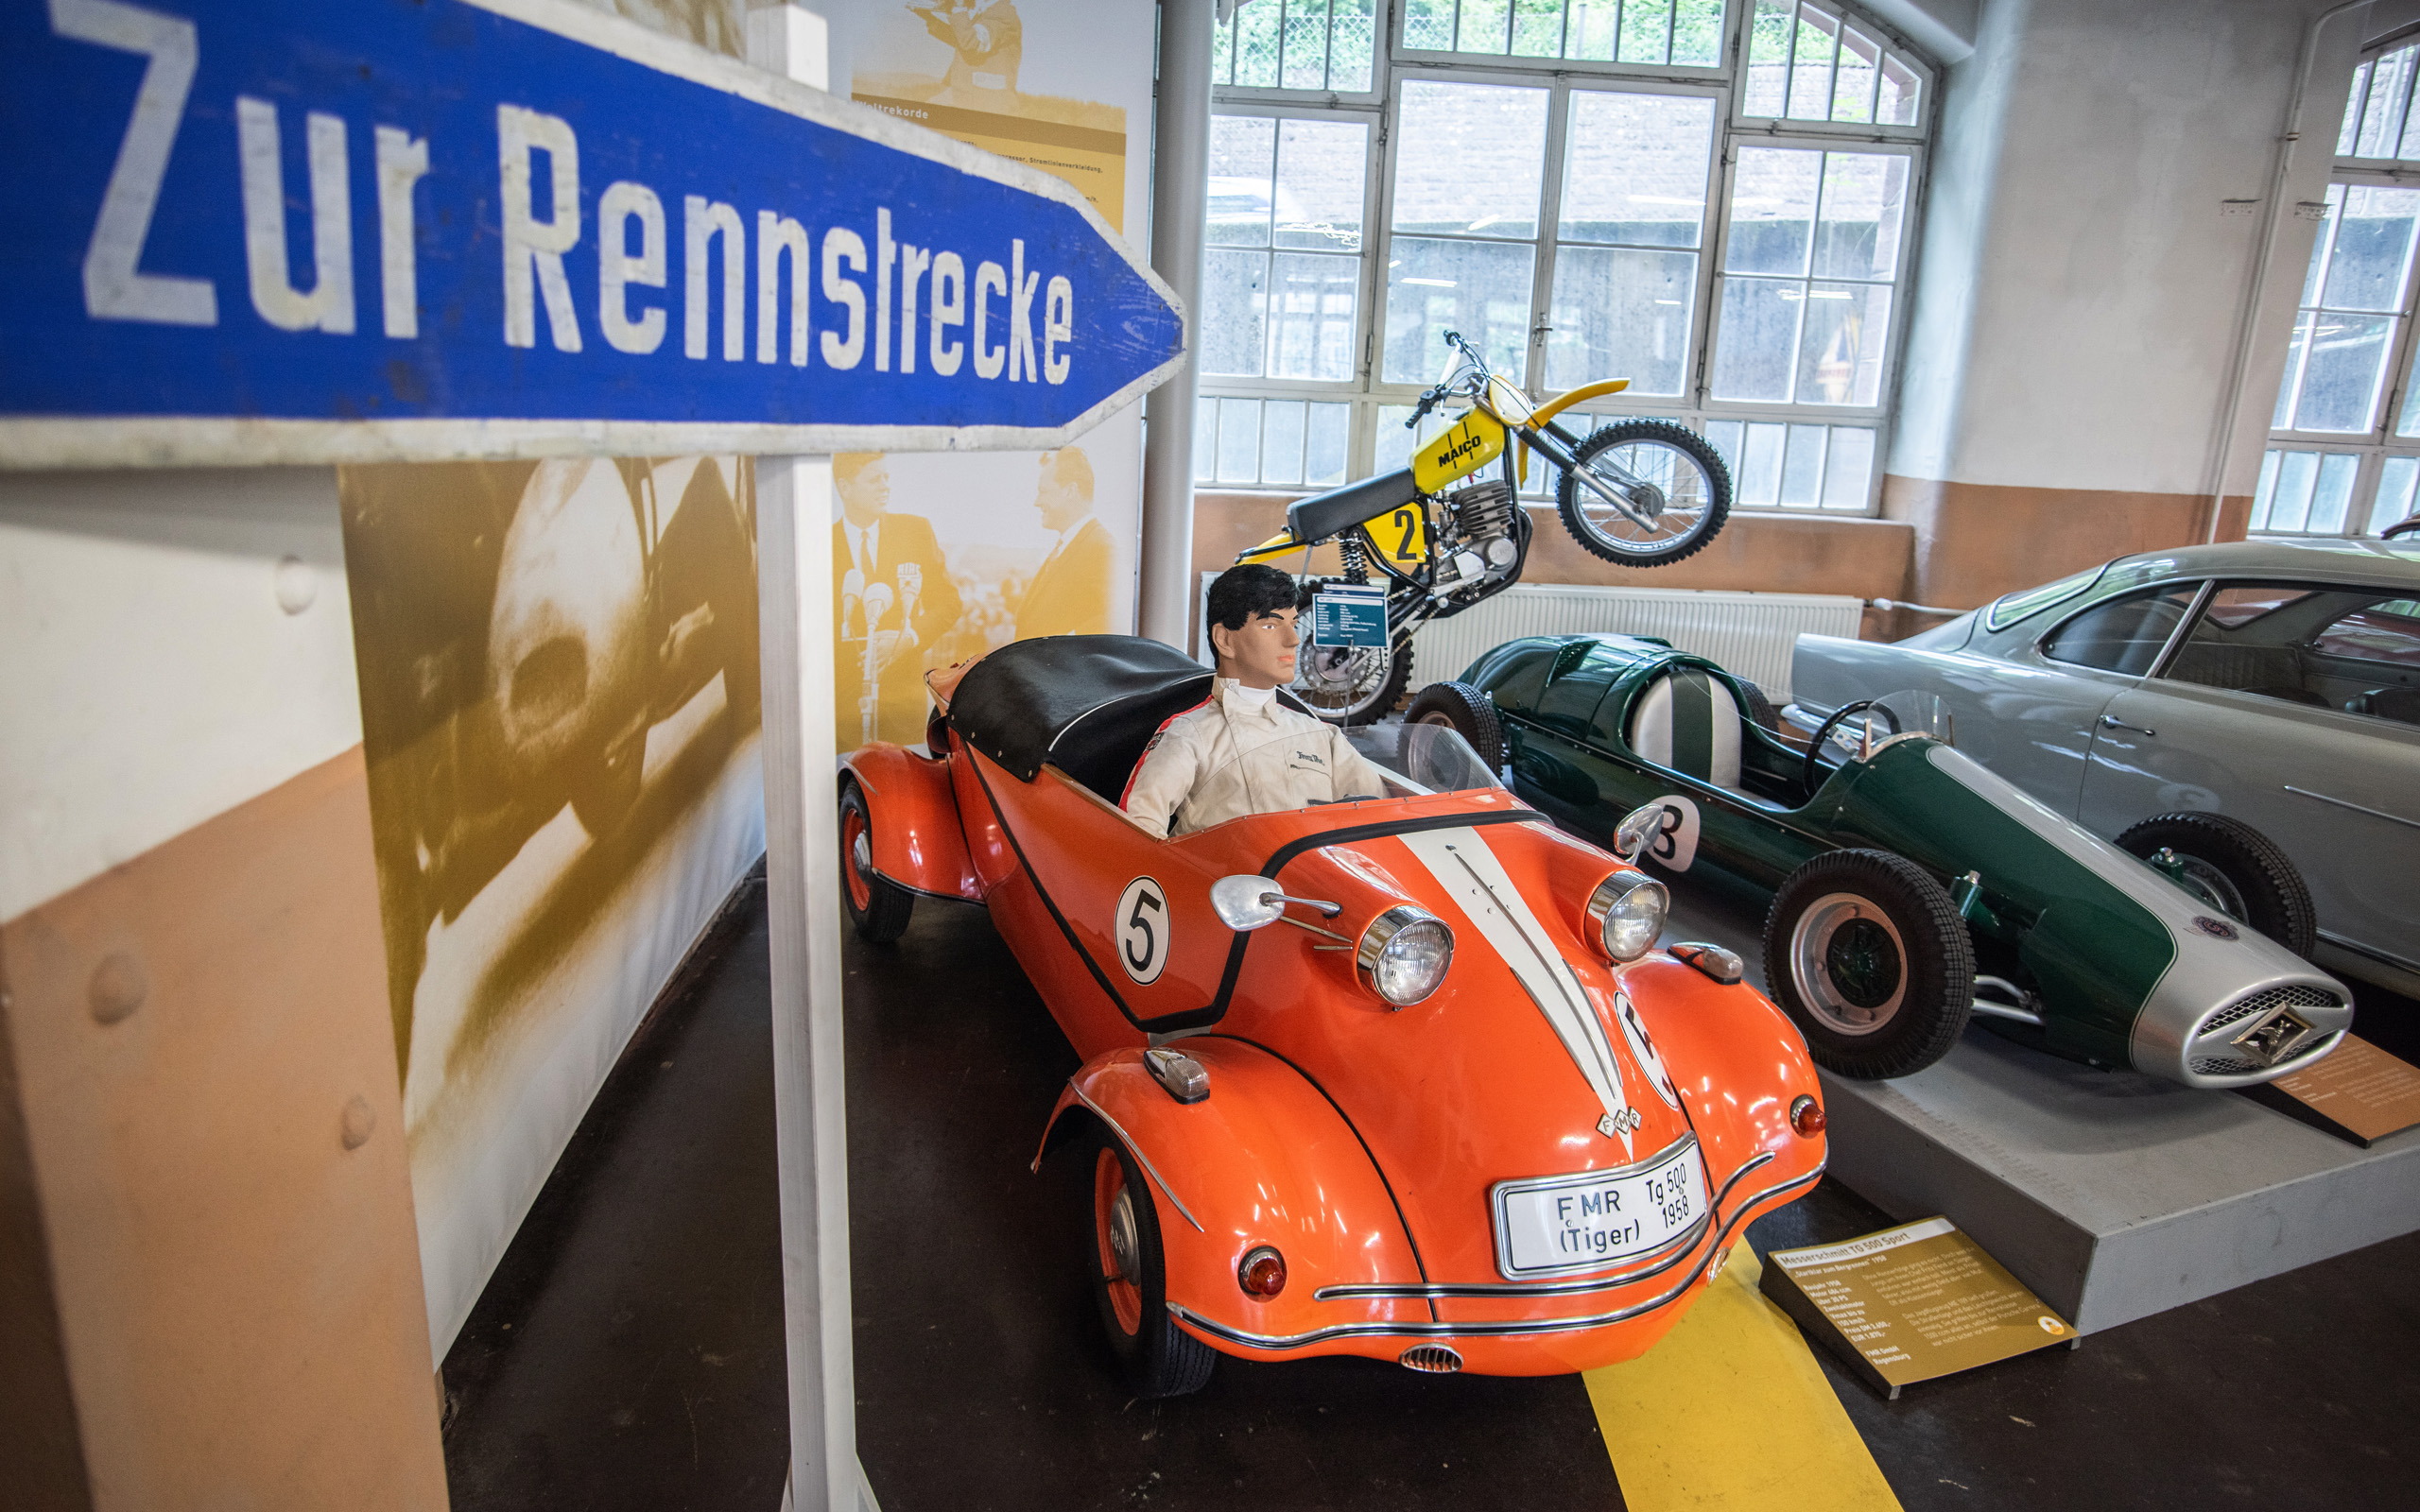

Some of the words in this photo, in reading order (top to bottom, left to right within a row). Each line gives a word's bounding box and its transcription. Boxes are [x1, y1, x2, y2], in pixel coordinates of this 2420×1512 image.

[50, 0, 428, 338] Zur
[497, 103, 1073, 386] Rennstrecke
[1438, 436, 1481, 468] MAICO
[1394, 509, 1417, 560] 2
[1125, 888, 1161, 971] 5
[1602, 1111, 1638, 1133] FMR
[1557, 1190, 1621, 1221] FMR
[1646, 1179, 1664, 1206] Tg
[1667, 1163, 1687, 1194] 500
[1561, 1219, 1640, 1253] (Tiger)
[1662, 1195, 1689, 1229] 1958
[1781, 1249, 1849, 1265] Messerschmitt
[1849, 1244, 1864, 1254] TG
[1863, 1239, 1882, 1249] 500
[1881, 1232, 1910, 1246] Sport
[1802, 1282, 1825, 1291] Baujahr
